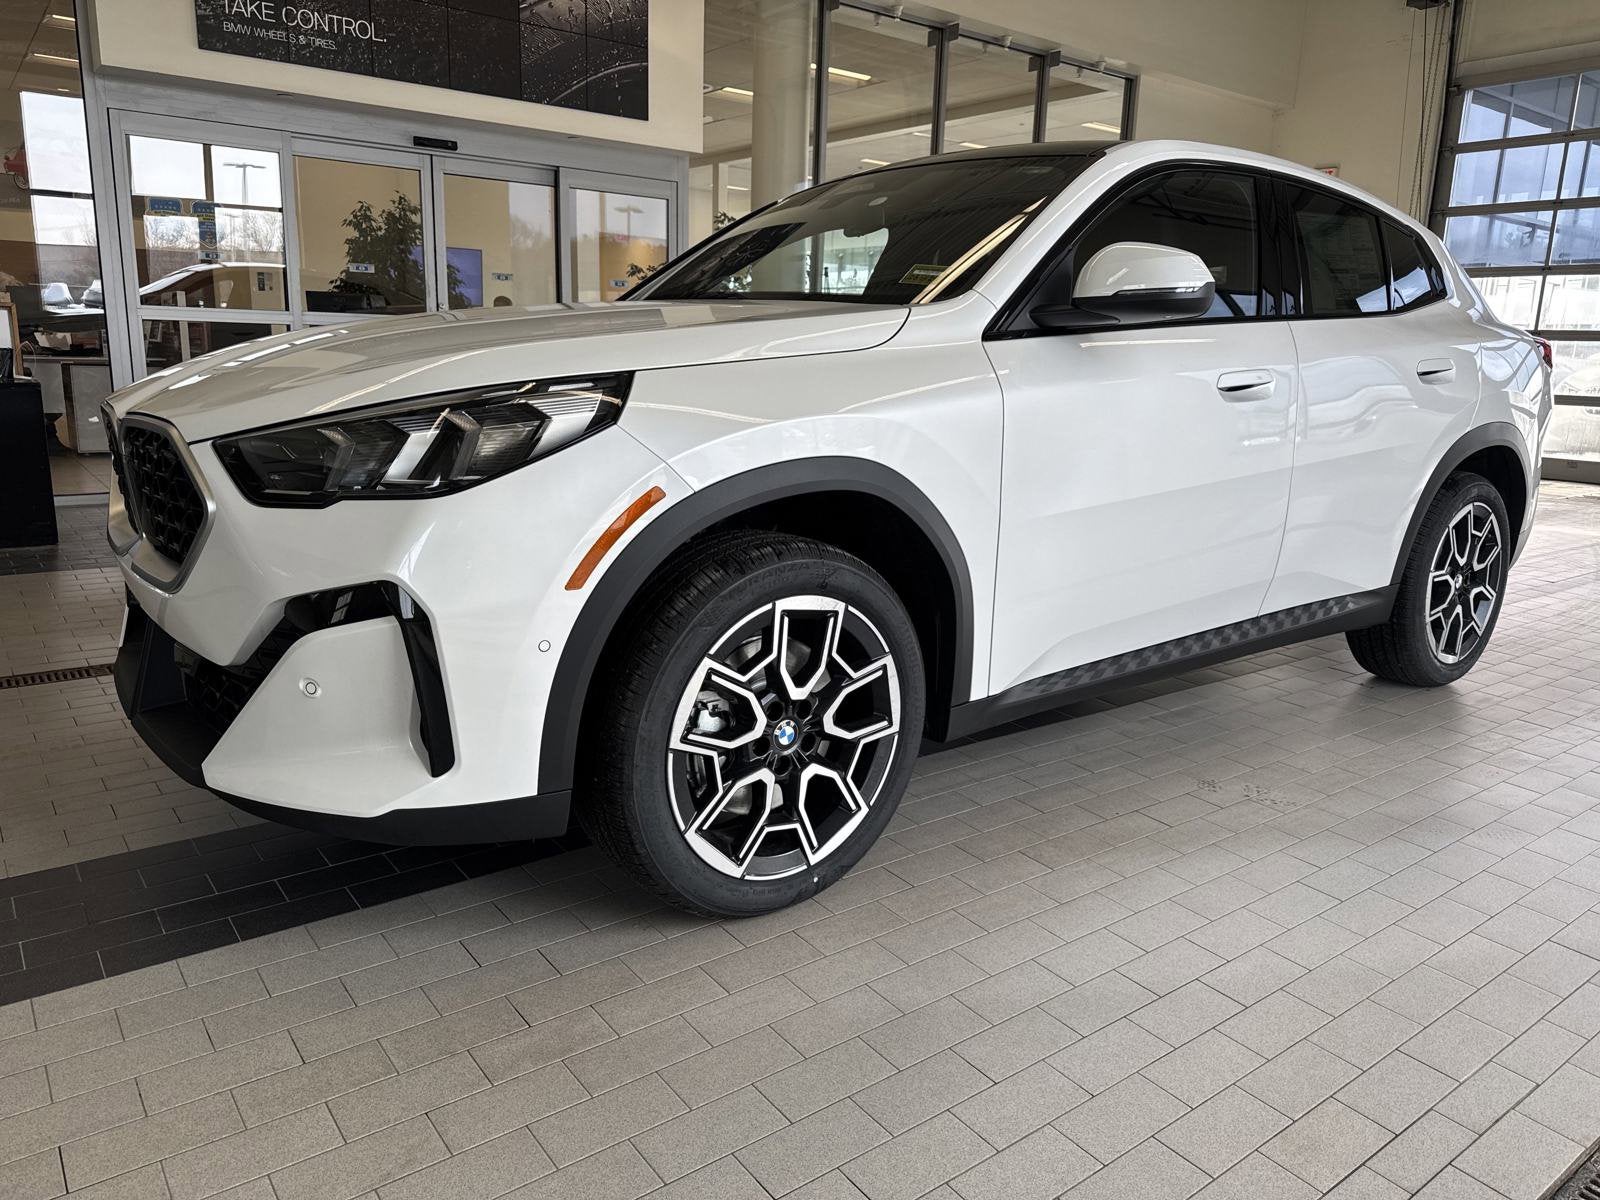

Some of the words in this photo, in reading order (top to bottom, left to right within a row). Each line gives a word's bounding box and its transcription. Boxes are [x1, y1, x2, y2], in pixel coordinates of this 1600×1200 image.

[223, 22, 252, 35] BMW
[253, 27, 298, 43] WHEELS
[299, 35, 306, 45] &
[309, 36, 338, 50] TIRES.
[225, 0, 276, 22] TAKE
[282, 6, 387, 43] CONTROL.
